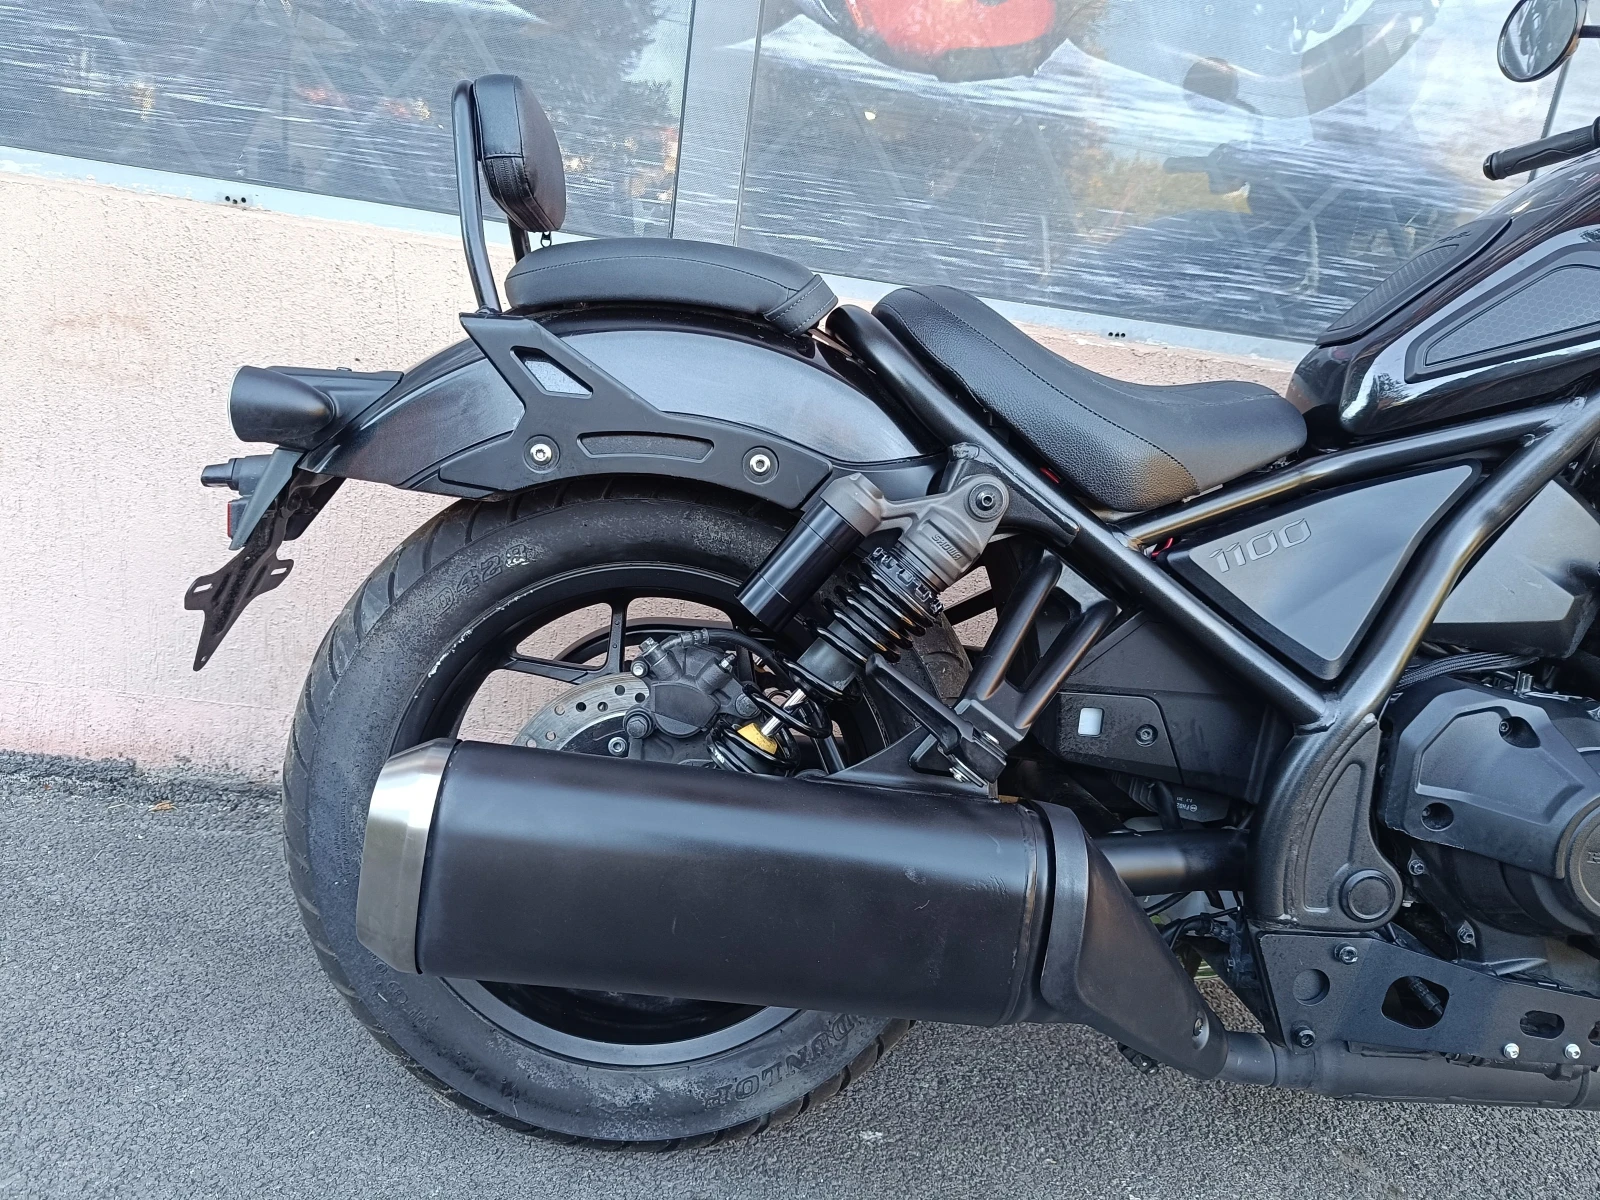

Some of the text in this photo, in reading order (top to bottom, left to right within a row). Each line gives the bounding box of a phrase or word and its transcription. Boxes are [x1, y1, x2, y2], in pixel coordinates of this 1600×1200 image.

[931, 534, 963, 561] SHOWA
[1209, 518, 1312, 573] 1100
[428, 543, 529, 619] D428
[704, 1013, 857, 1110] DUNLOP
